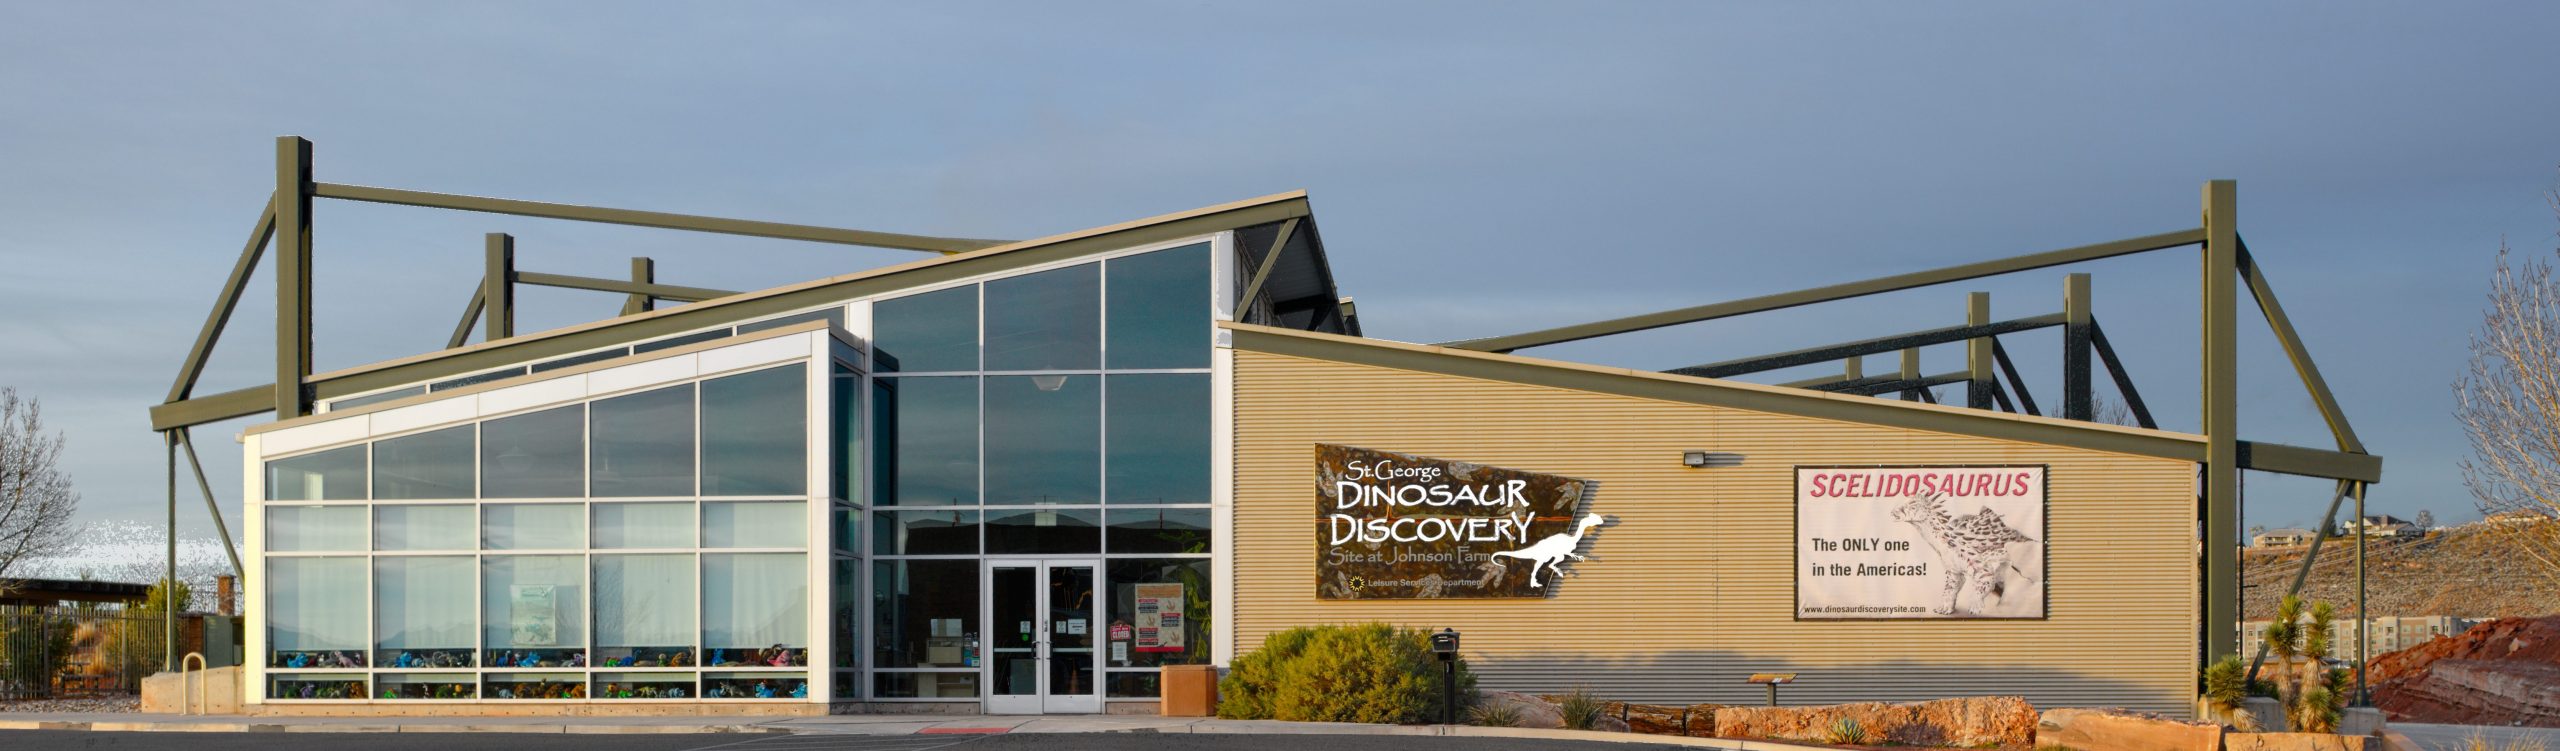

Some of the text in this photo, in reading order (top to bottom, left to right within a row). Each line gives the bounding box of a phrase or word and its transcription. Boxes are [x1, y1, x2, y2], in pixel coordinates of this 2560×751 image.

[1810, 472, 2030, 497] SCELIDOSAURUS
[1336, 479, 1530, 510] DINOSAUR
[1330, 511, 1536, 545] DISCOVERY
[1812, 538, 1910, 552] The ONLY one
[1328, 546, 1491, 566] Site at Johnson Farm
[1812, 563, 1927, 577] in the Americas!
[1368, 579, 1398, 587] Leisure
[1804, 605, 1926, 614] www.dinosaurdiscoverysite.com
